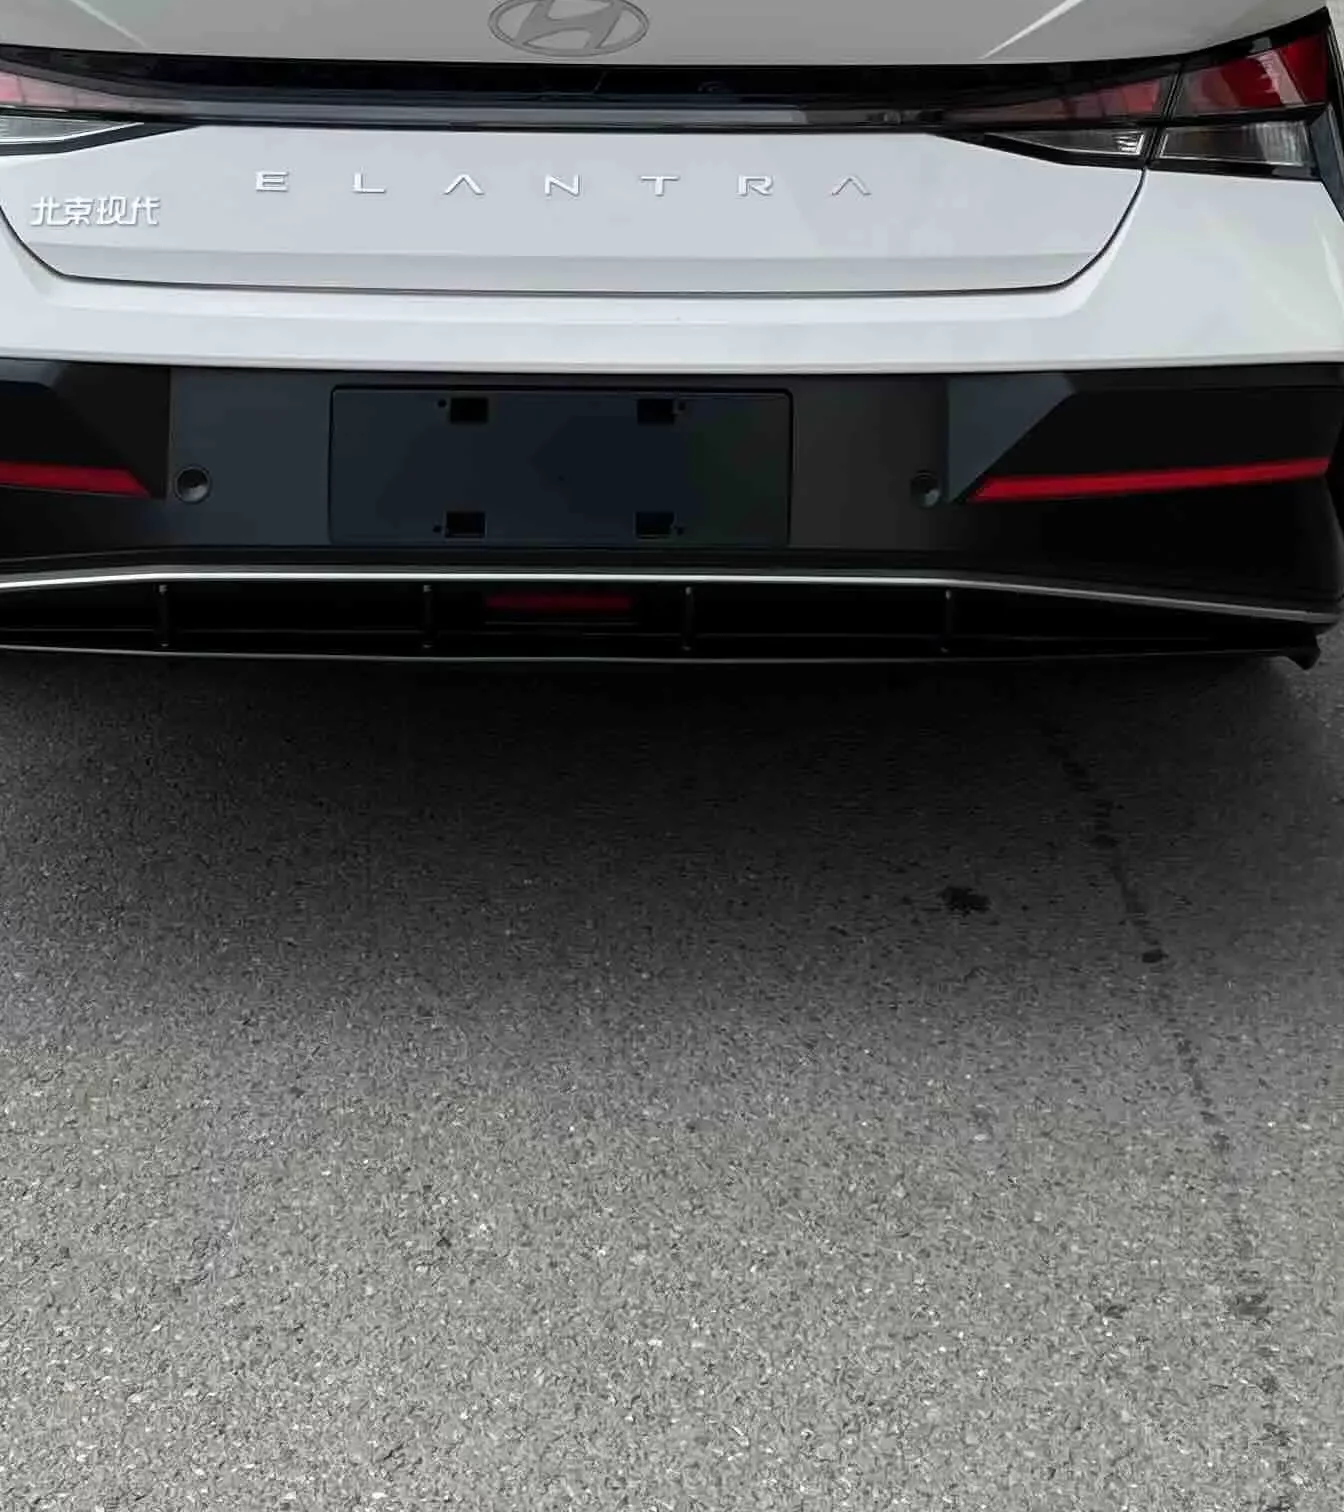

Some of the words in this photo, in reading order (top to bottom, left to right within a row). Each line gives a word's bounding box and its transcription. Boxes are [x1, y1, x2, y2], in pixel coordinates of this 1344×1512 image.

[254, 169, 872, 198] ELANTRA
[30, 195, 161, 227] 北京现代
